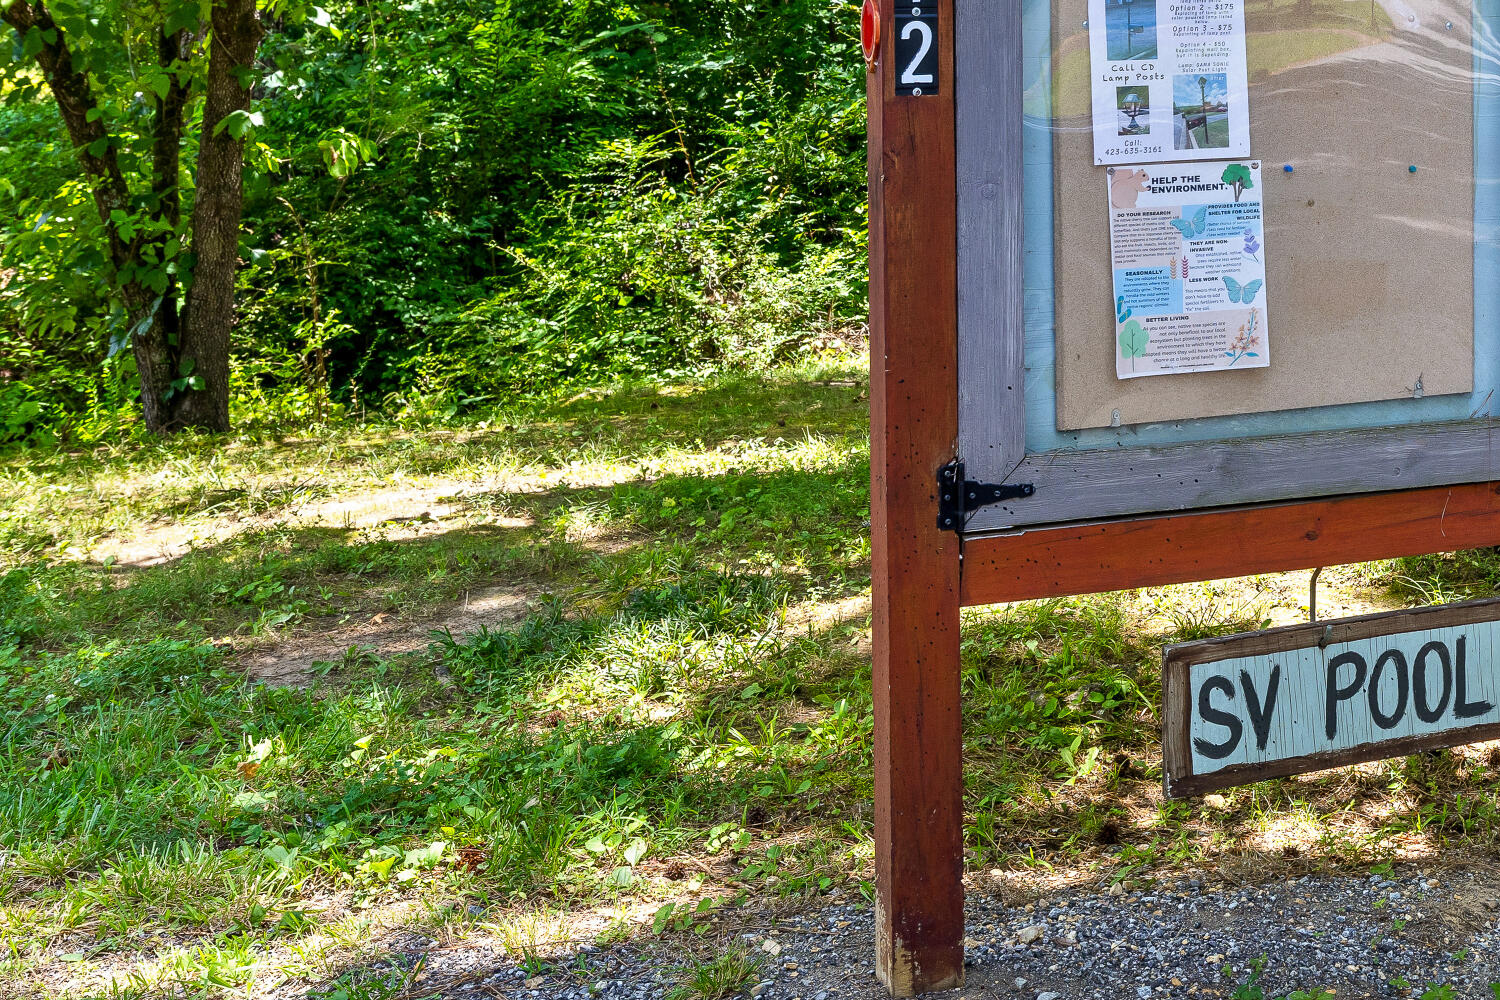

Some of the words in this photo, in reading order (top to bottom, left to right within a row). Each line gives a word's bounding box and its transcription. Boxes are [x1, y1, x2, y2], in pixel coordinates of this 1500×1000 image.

[1169, 4, 1196, 14] Option
[1215, 3, 1234, 11] $175
[1172, 25, 1199, 34] Option
[1111, 64, 1135, 72] Call
[1102, 74, 1130, 85] Lamp
[1136, 72, 1165, 81] Posts
[1151, 177, 1178, 185] HELP
[1180, 175, 1201, 183] THE
[1151, 183, 1228, 194] ENVIRONMENT.
[1194, 663, 1280, 759] SV
[1325, 634, 1495, 741] POOL
